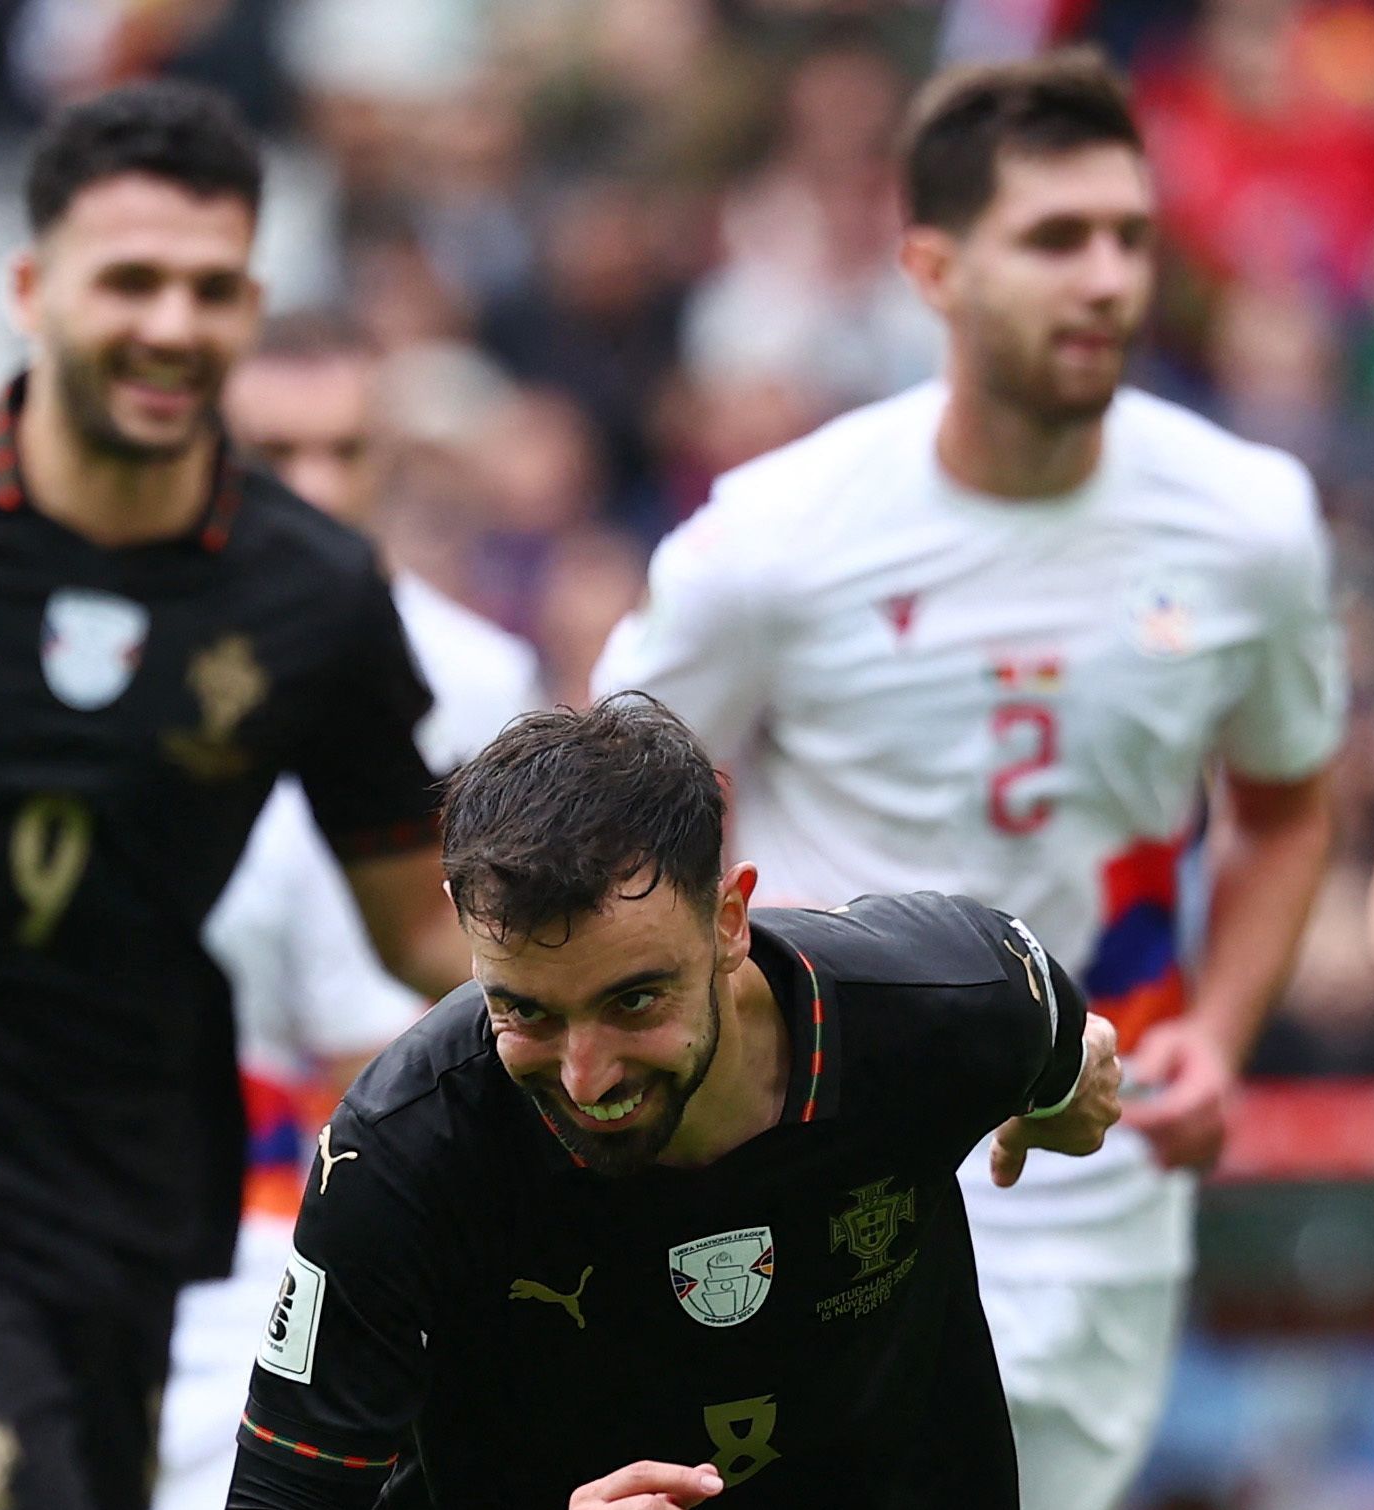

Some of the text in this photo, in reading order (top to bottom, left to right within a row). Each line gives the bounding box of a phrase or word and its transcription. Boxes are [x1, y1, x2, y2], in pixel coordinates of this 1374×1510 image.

[988, 703, 1059, 837] 2
[10, 797, 93, 945] 9
[696, 1236, 732, 1248] NATIONS
[734, 1231, 766, 1240] LEAGUE
[704, 1393, 782, 1489] 8
